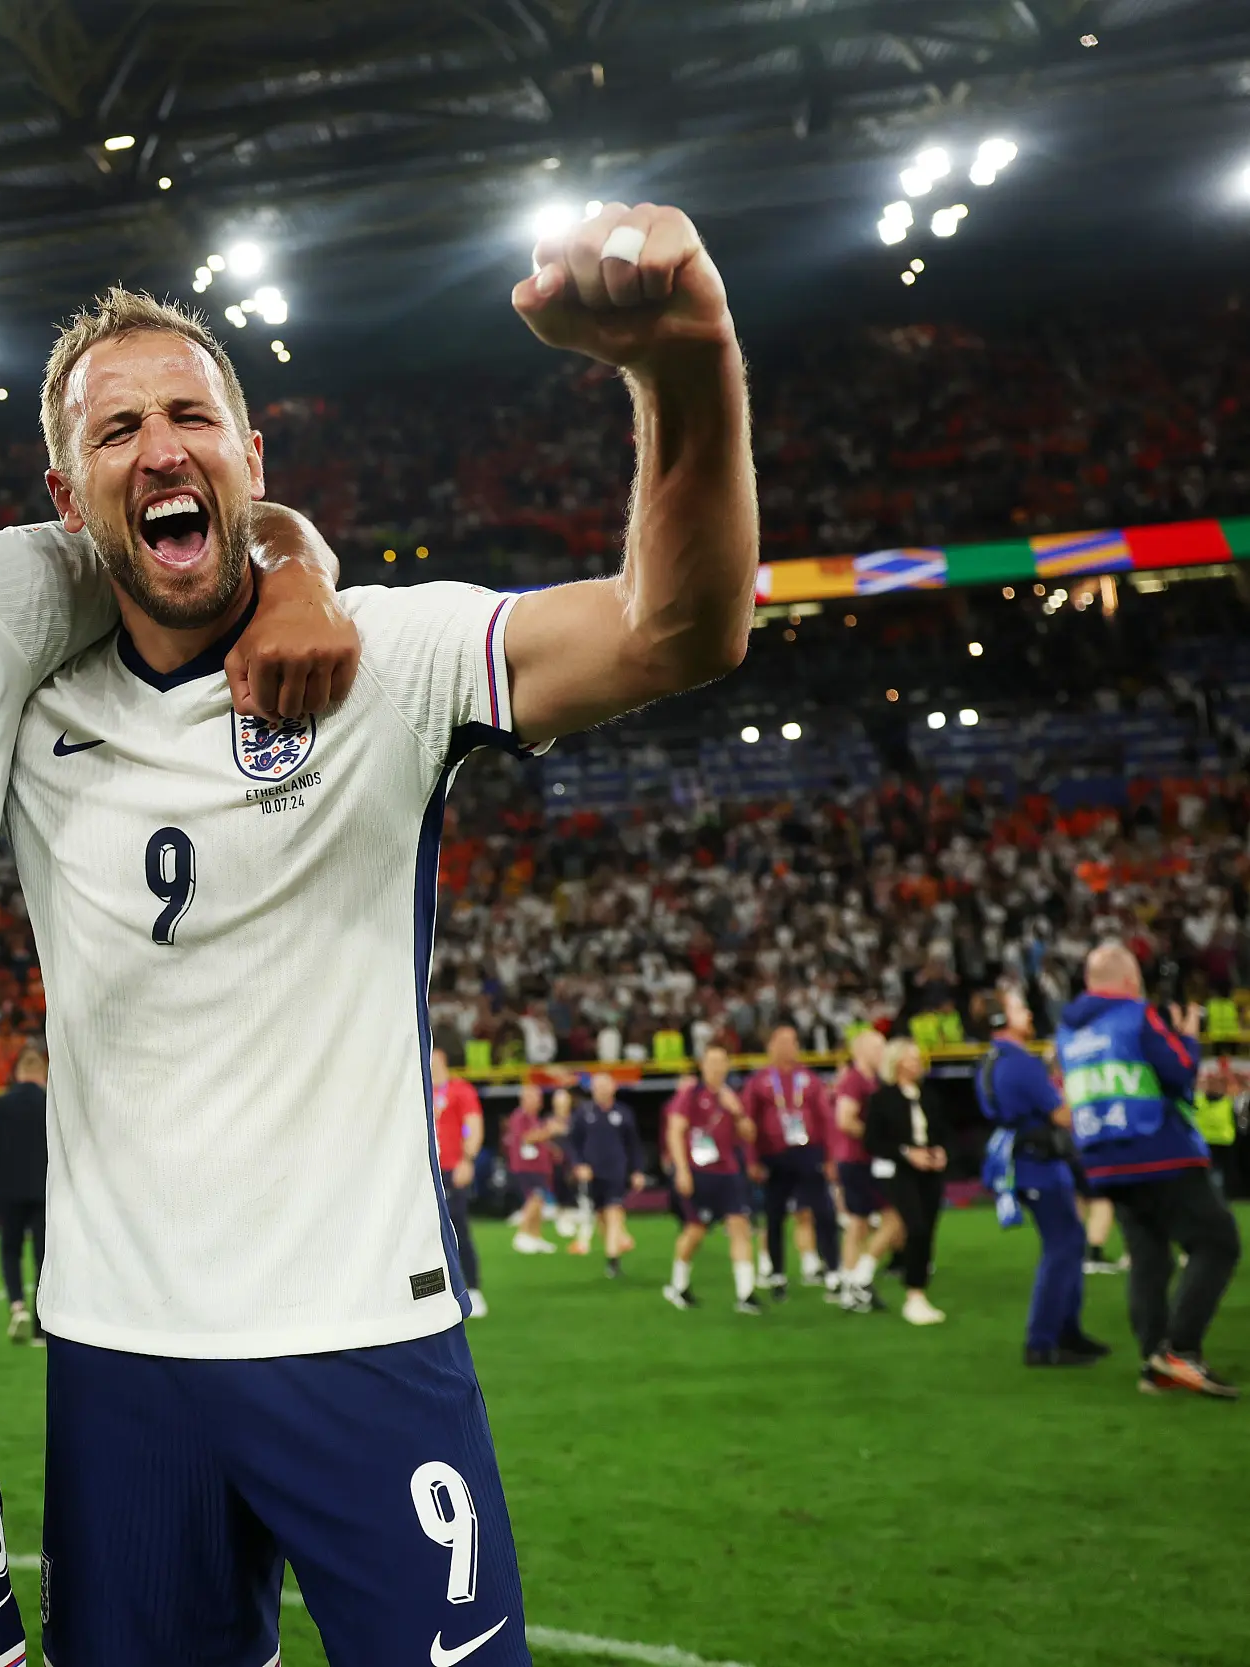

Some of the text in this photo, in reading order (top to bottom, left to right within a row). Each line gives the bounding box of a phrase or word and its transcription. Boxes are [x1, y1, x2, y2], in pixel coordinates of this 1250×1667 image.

[245, 771, 322, 801] ETHERLANDS
[259, 794, 305, 815] 10.07.24
[145, 826, 196, 946] 9
[410, 1460, 479, 1605] 9
